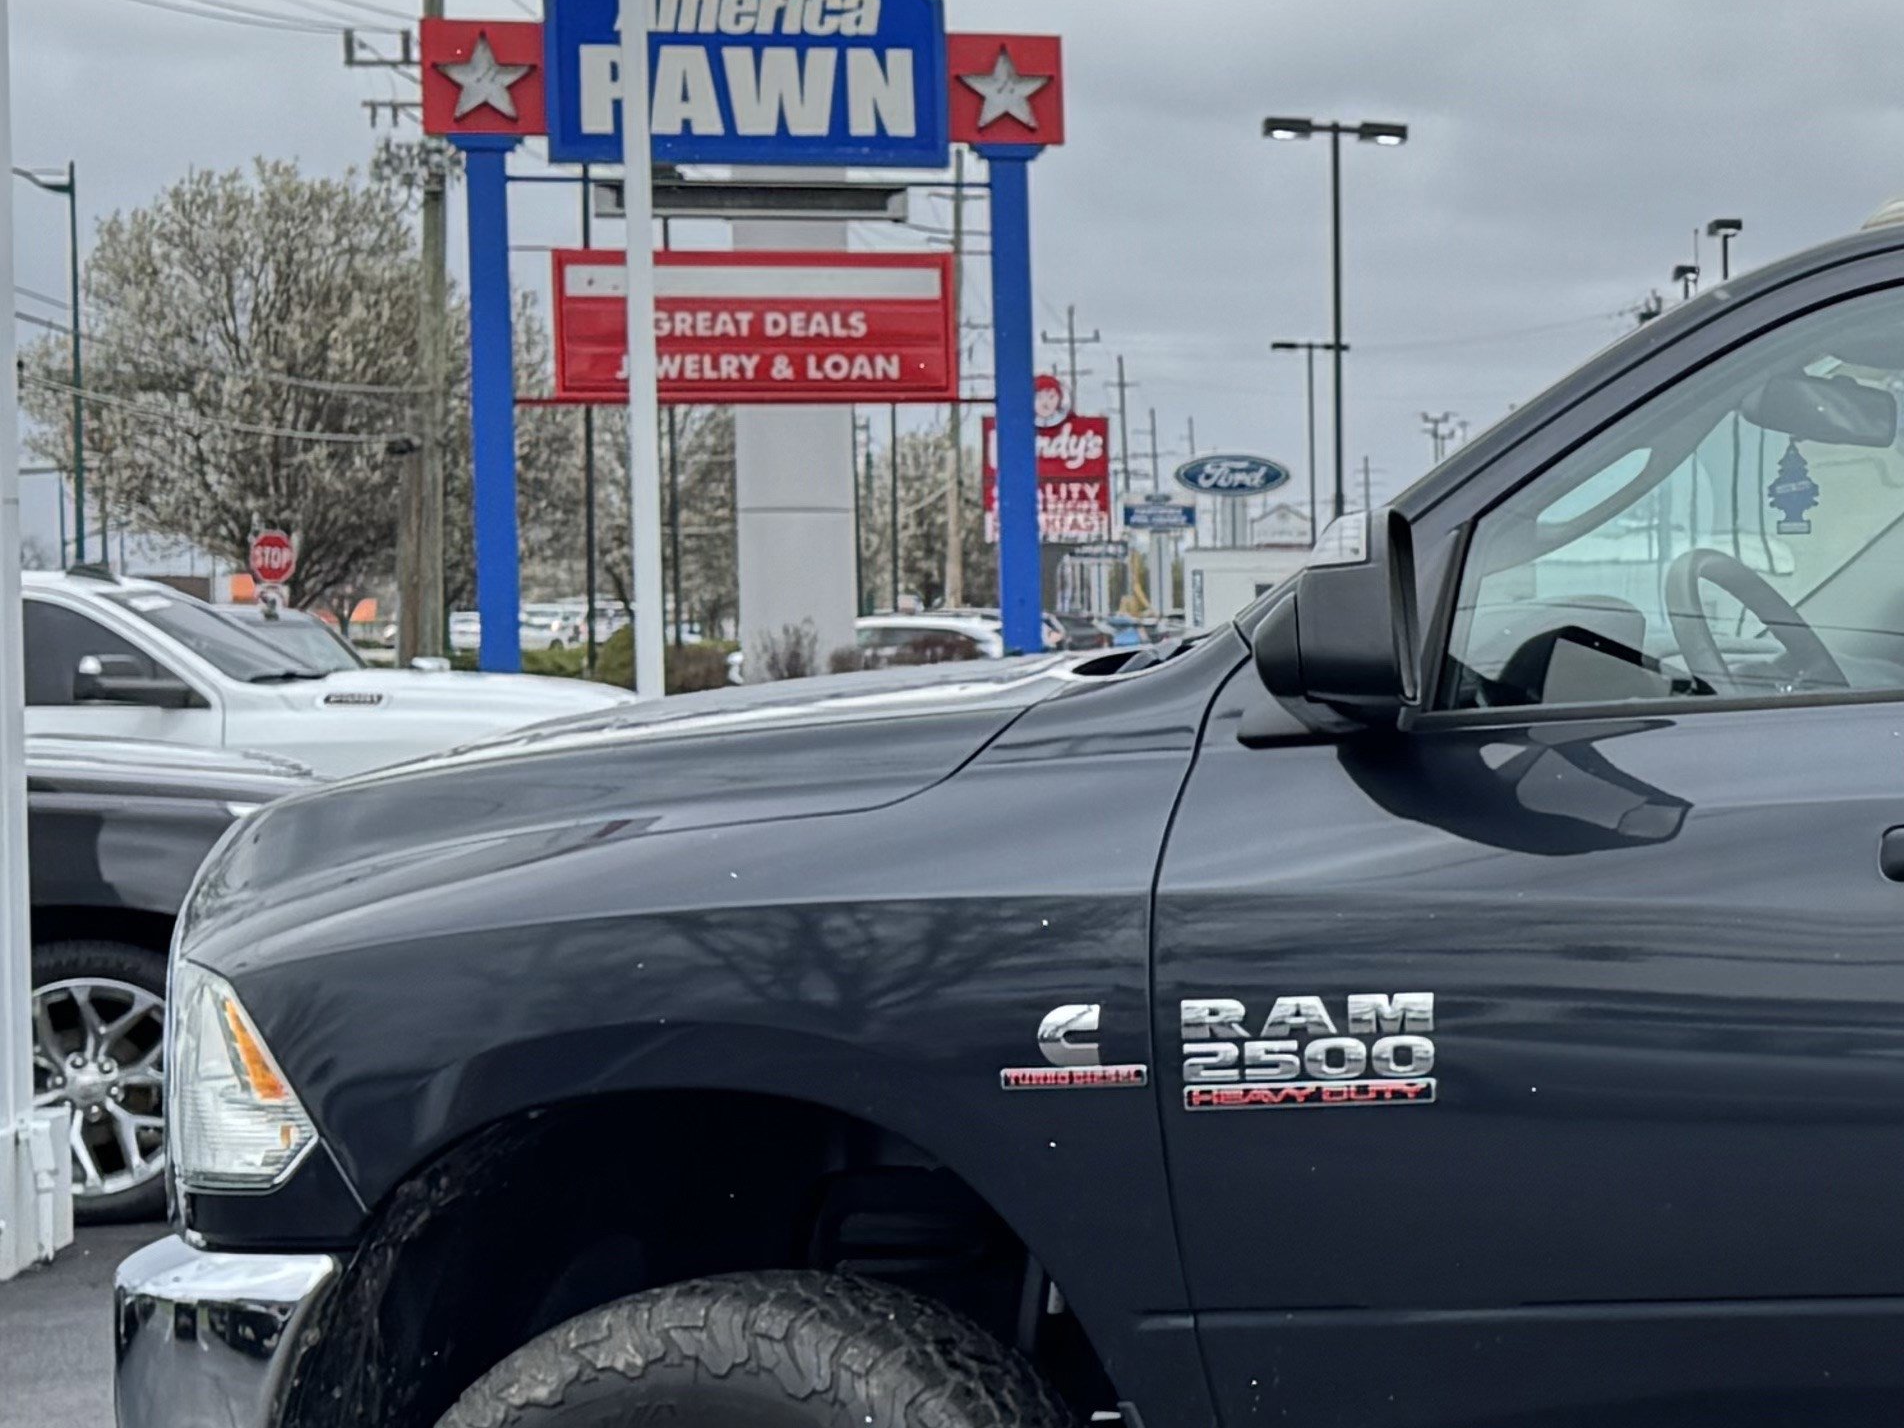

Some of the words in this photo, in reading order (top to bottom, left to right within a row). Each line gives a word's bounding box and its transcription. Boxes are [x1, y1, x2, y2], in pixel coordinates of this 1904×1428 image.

[653, 311, 753, 338] GREAT
[765, 311, 868, 338] DEALS
[615, 353, 760, 380] JWELRY
[771, 354, 794, 380] &
[806, 354, 900, 380] LOAN
[1198, 461, 1269, 488] Ford
[254, 546, 294, 569] STOP
[1181, 992, 1435, 1039] RAM
[1183, 1035, 1435, 1082] 2500
[1192, 1086, 1317, 1106] HEAVY
[1321, 1083, 1428, 1103] DUTY
